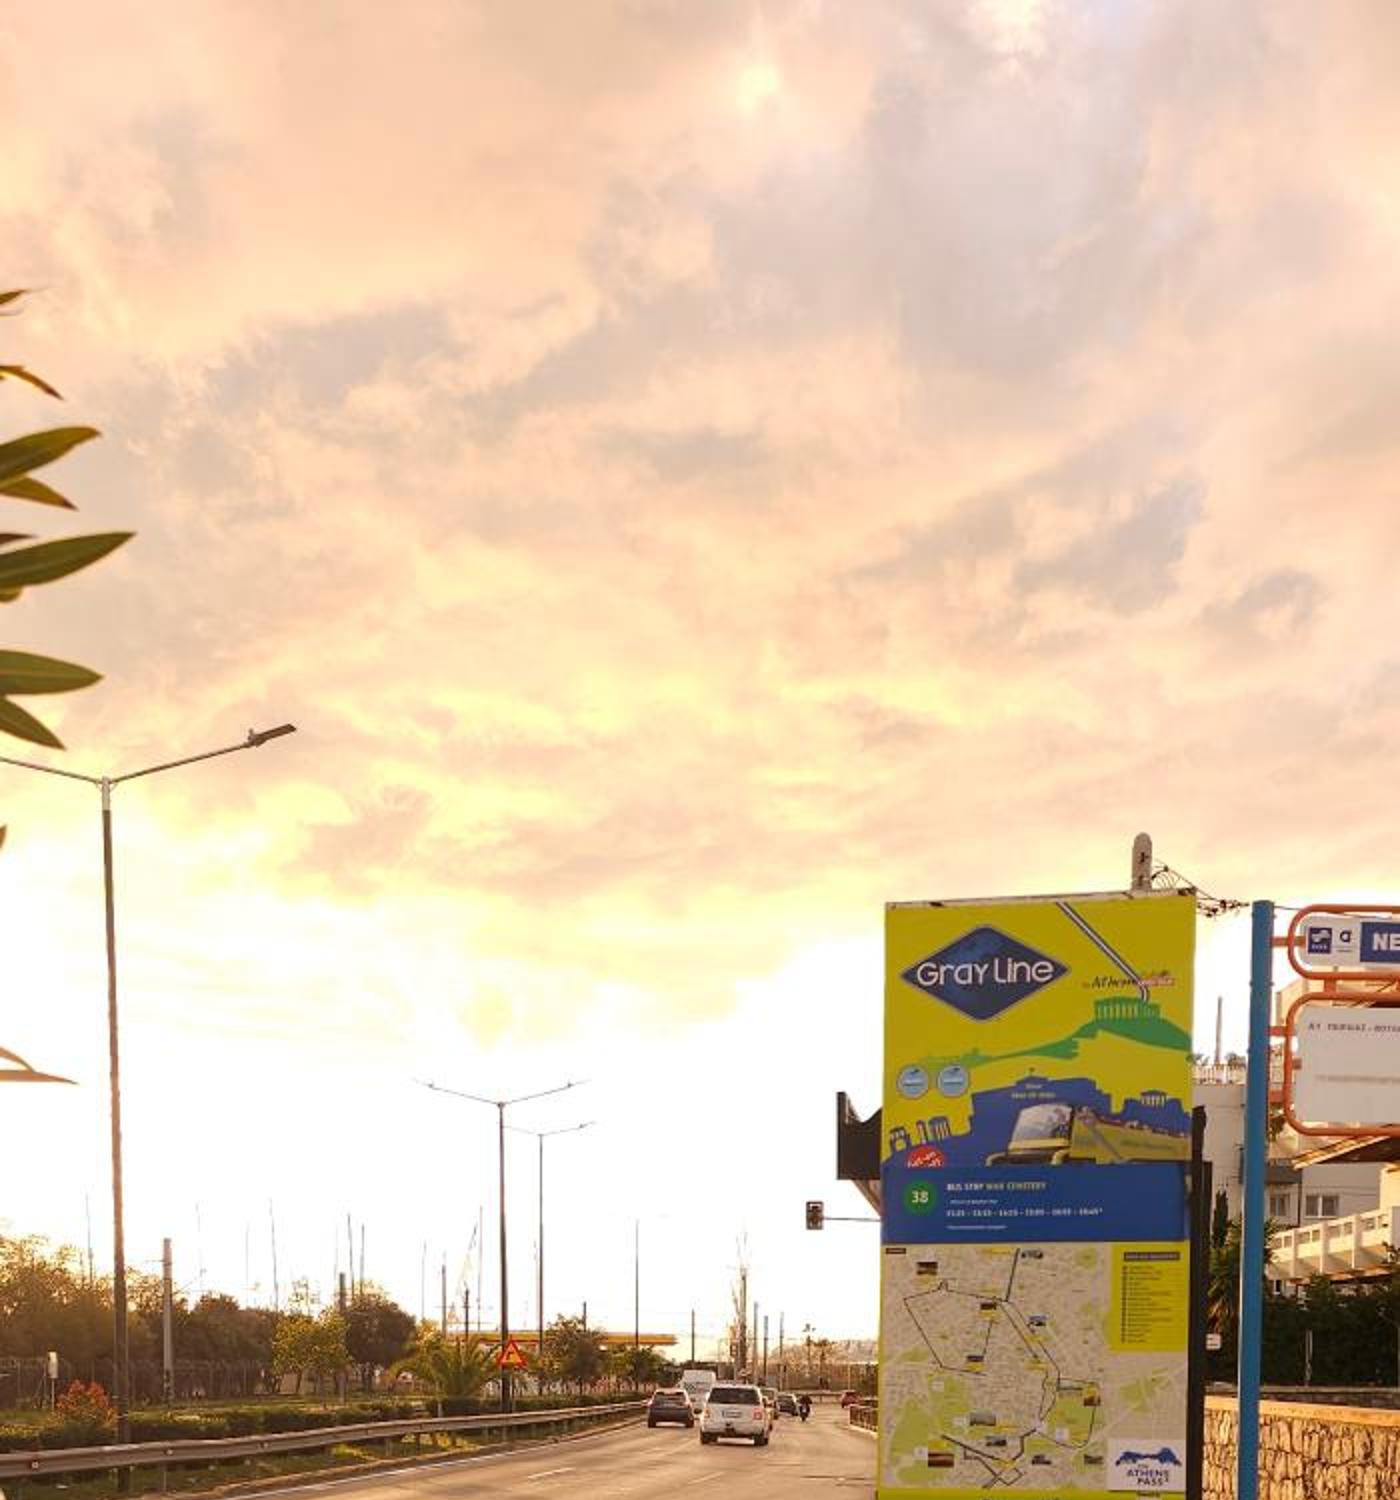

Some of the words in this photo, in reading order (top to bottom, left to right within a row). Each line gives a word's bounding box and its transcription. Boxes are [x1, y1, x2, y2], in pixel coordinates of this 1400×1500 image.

[916, 961, 988, 986] Gray
[993, 956, 1056, 984] Line
[911, 1189, 929, 1204] 38
[1137, 1478, 1163, 1486] PASS
